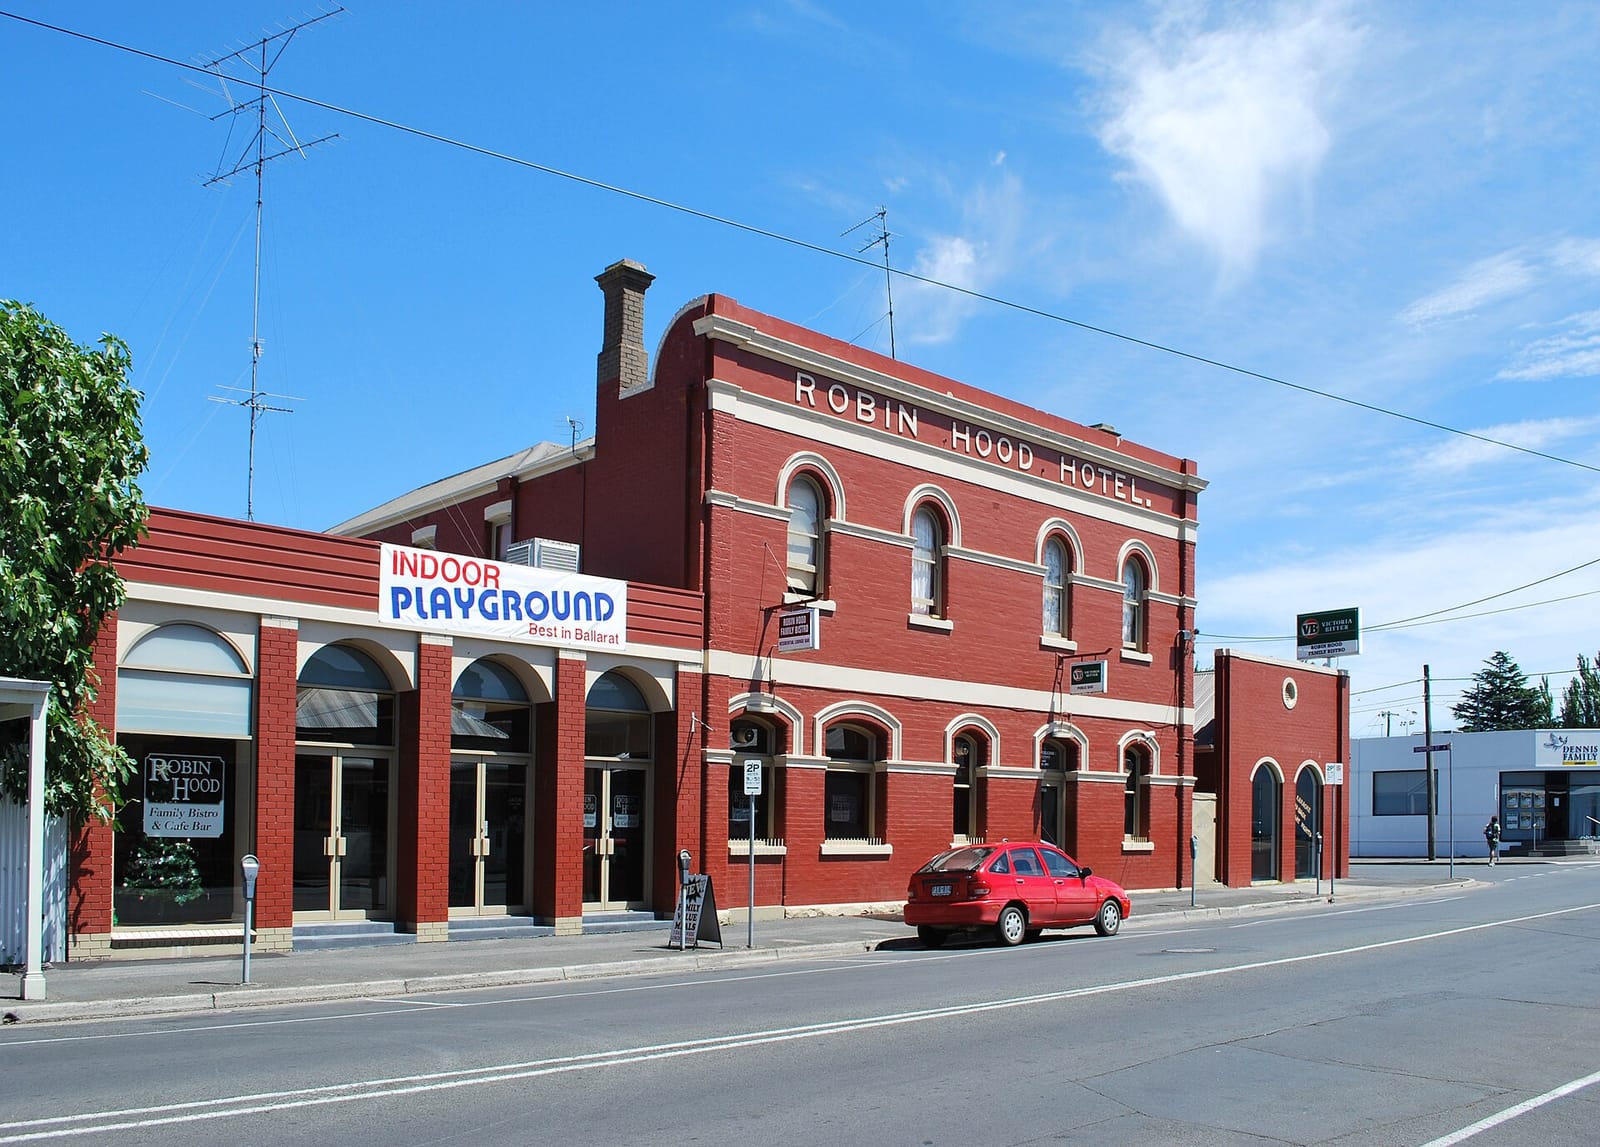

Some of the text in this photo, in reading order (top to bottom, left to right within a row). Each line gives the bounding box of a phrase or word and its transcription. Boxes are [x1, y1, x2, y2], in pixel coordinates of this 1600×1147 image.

[795, 371, 1151, 507] ROBIN HOOD HOTEL.
[392, 550, 500, 589] INDOOR
[391, 586, 614, 621] PLAYGROUND
[528, 623, 619, 645] Best in Ballarat
[781, 626, 794, 636] FAMILY
[1302, 618, 1353, 636] VB VICTORIA
[1563, 745, 1598, 753] DENNIS
[1563, 753, 1598, 761] FAMILY
[148, 758, 212, 782] ROBIN
[746, 763, 760, 773] 2P
[171, 777, 220, 800] HOOD
[149, 807, 218, 819] Family Bistro
[151, 820, 212, 831] & Cafe Bar
